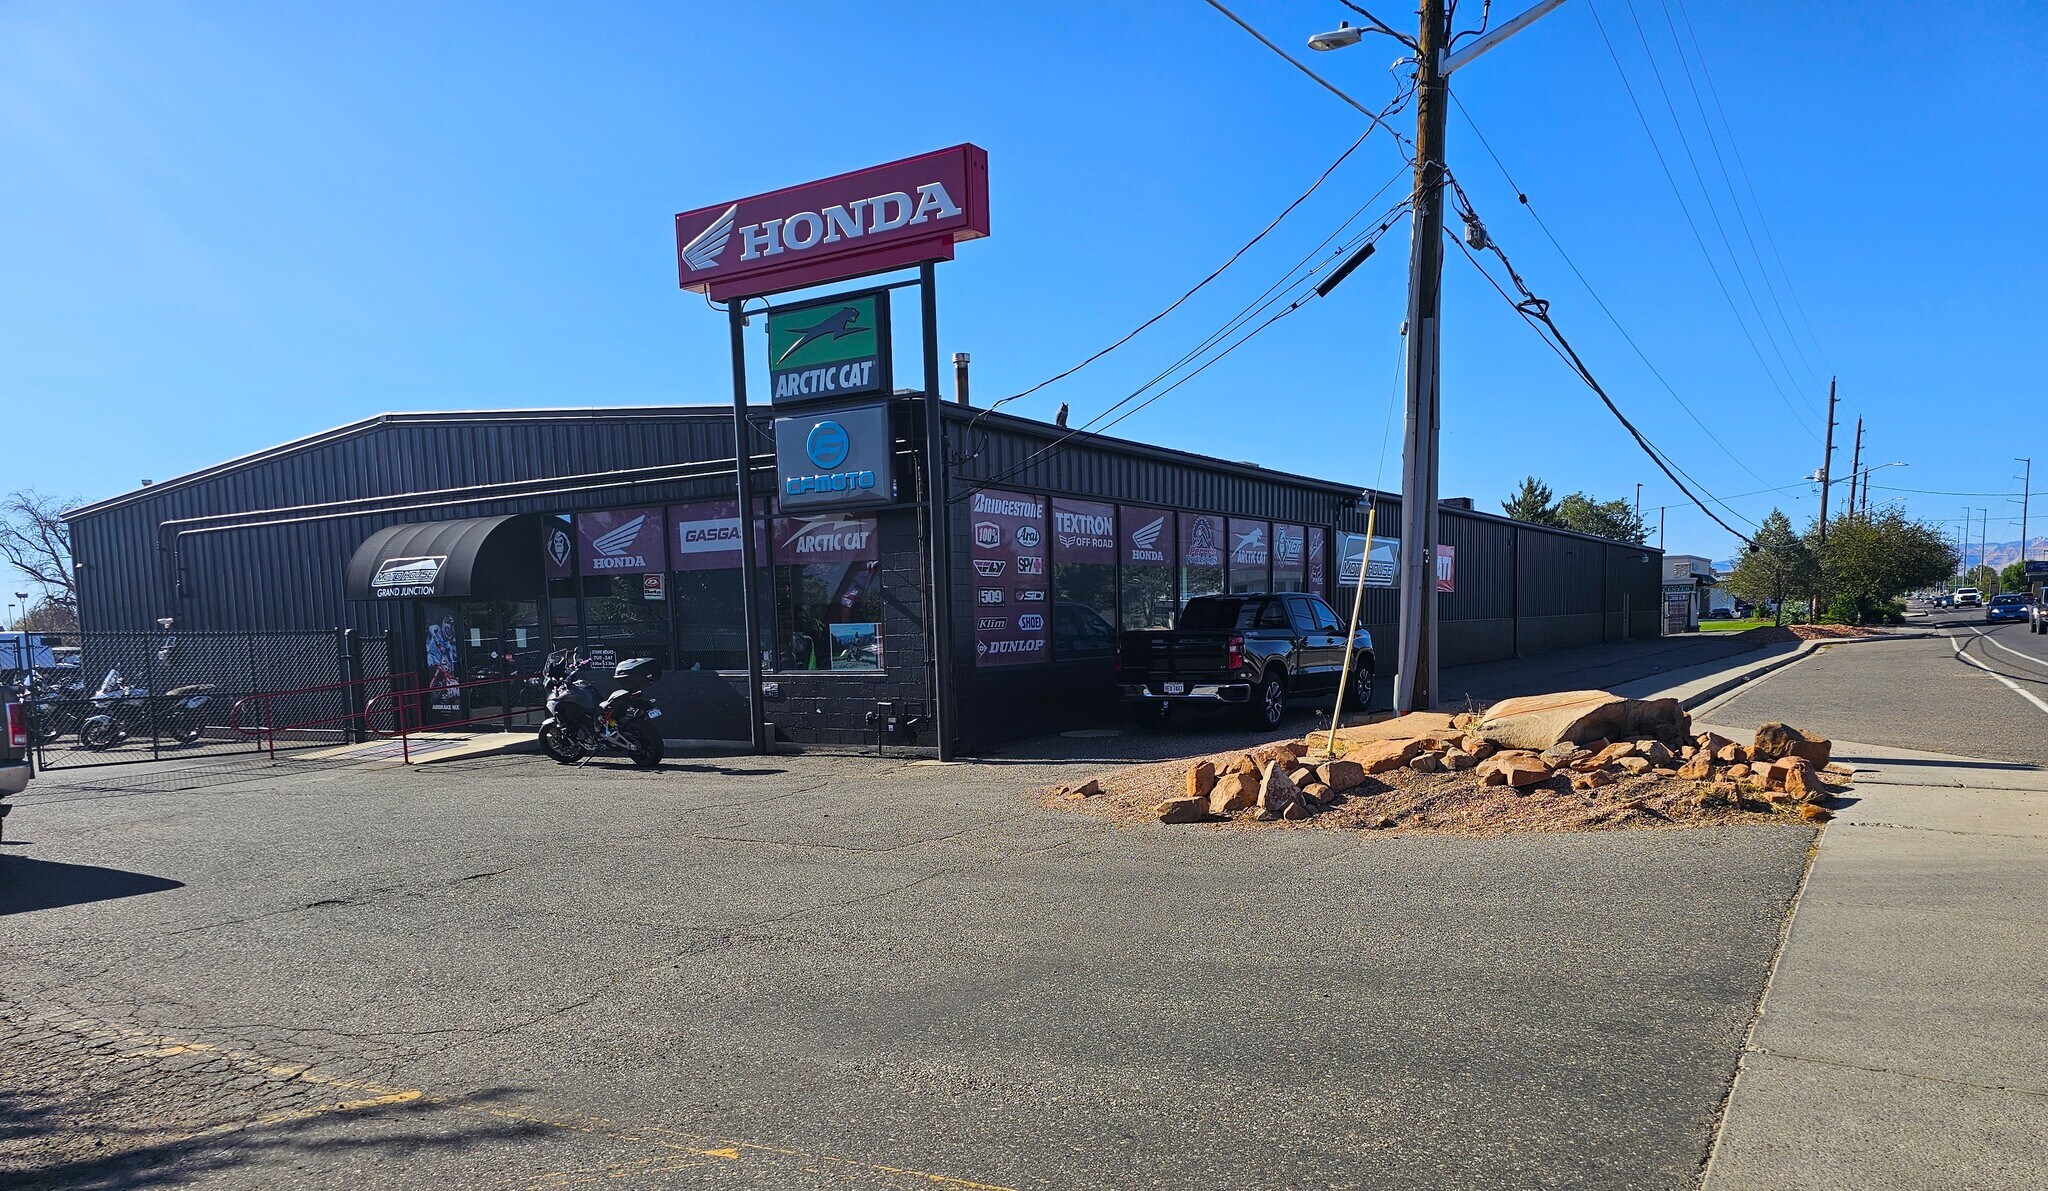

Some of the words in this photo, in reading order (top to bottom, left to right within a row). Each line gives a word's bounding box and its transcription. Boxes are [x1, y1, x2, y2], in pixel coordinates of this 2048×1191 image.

[739, 181, 963, 262] HONDA
[775, 366, 837, 399] ARCTIC
[839, 360, 874, 389] CAT
[786, 470, 876, 496] CFMOTO
[972, 493, 1043, 519] BRIDGESTONE
[1055, 512, 1113, 536] TEXTRON
[795, 533, 842, 553] ARCTIC
[844, 531, 871, 550] CAT
[979, 527, 998, 543] 100%
[1017, 527, 1039, 542] Arai
[1076, 537, 1091, 547] OFF
[1092, 538, 1113, 548] ROAD
[592, 555, 646, 569] HONDA
[1132, 550, 1164, 561] HONDA
[1237, 549, 1256, 564] ARCTIC
[377, 587, 400, 598] GRAND
[400, 585, 435, 596] JUNCTION
[981, 590, 1002, 603] 509
[979, 619, 1005, 629] Klim
[1021, 616, 1042, 629] SHOEI
[989, 640, 1044, 654] DUNLOP
